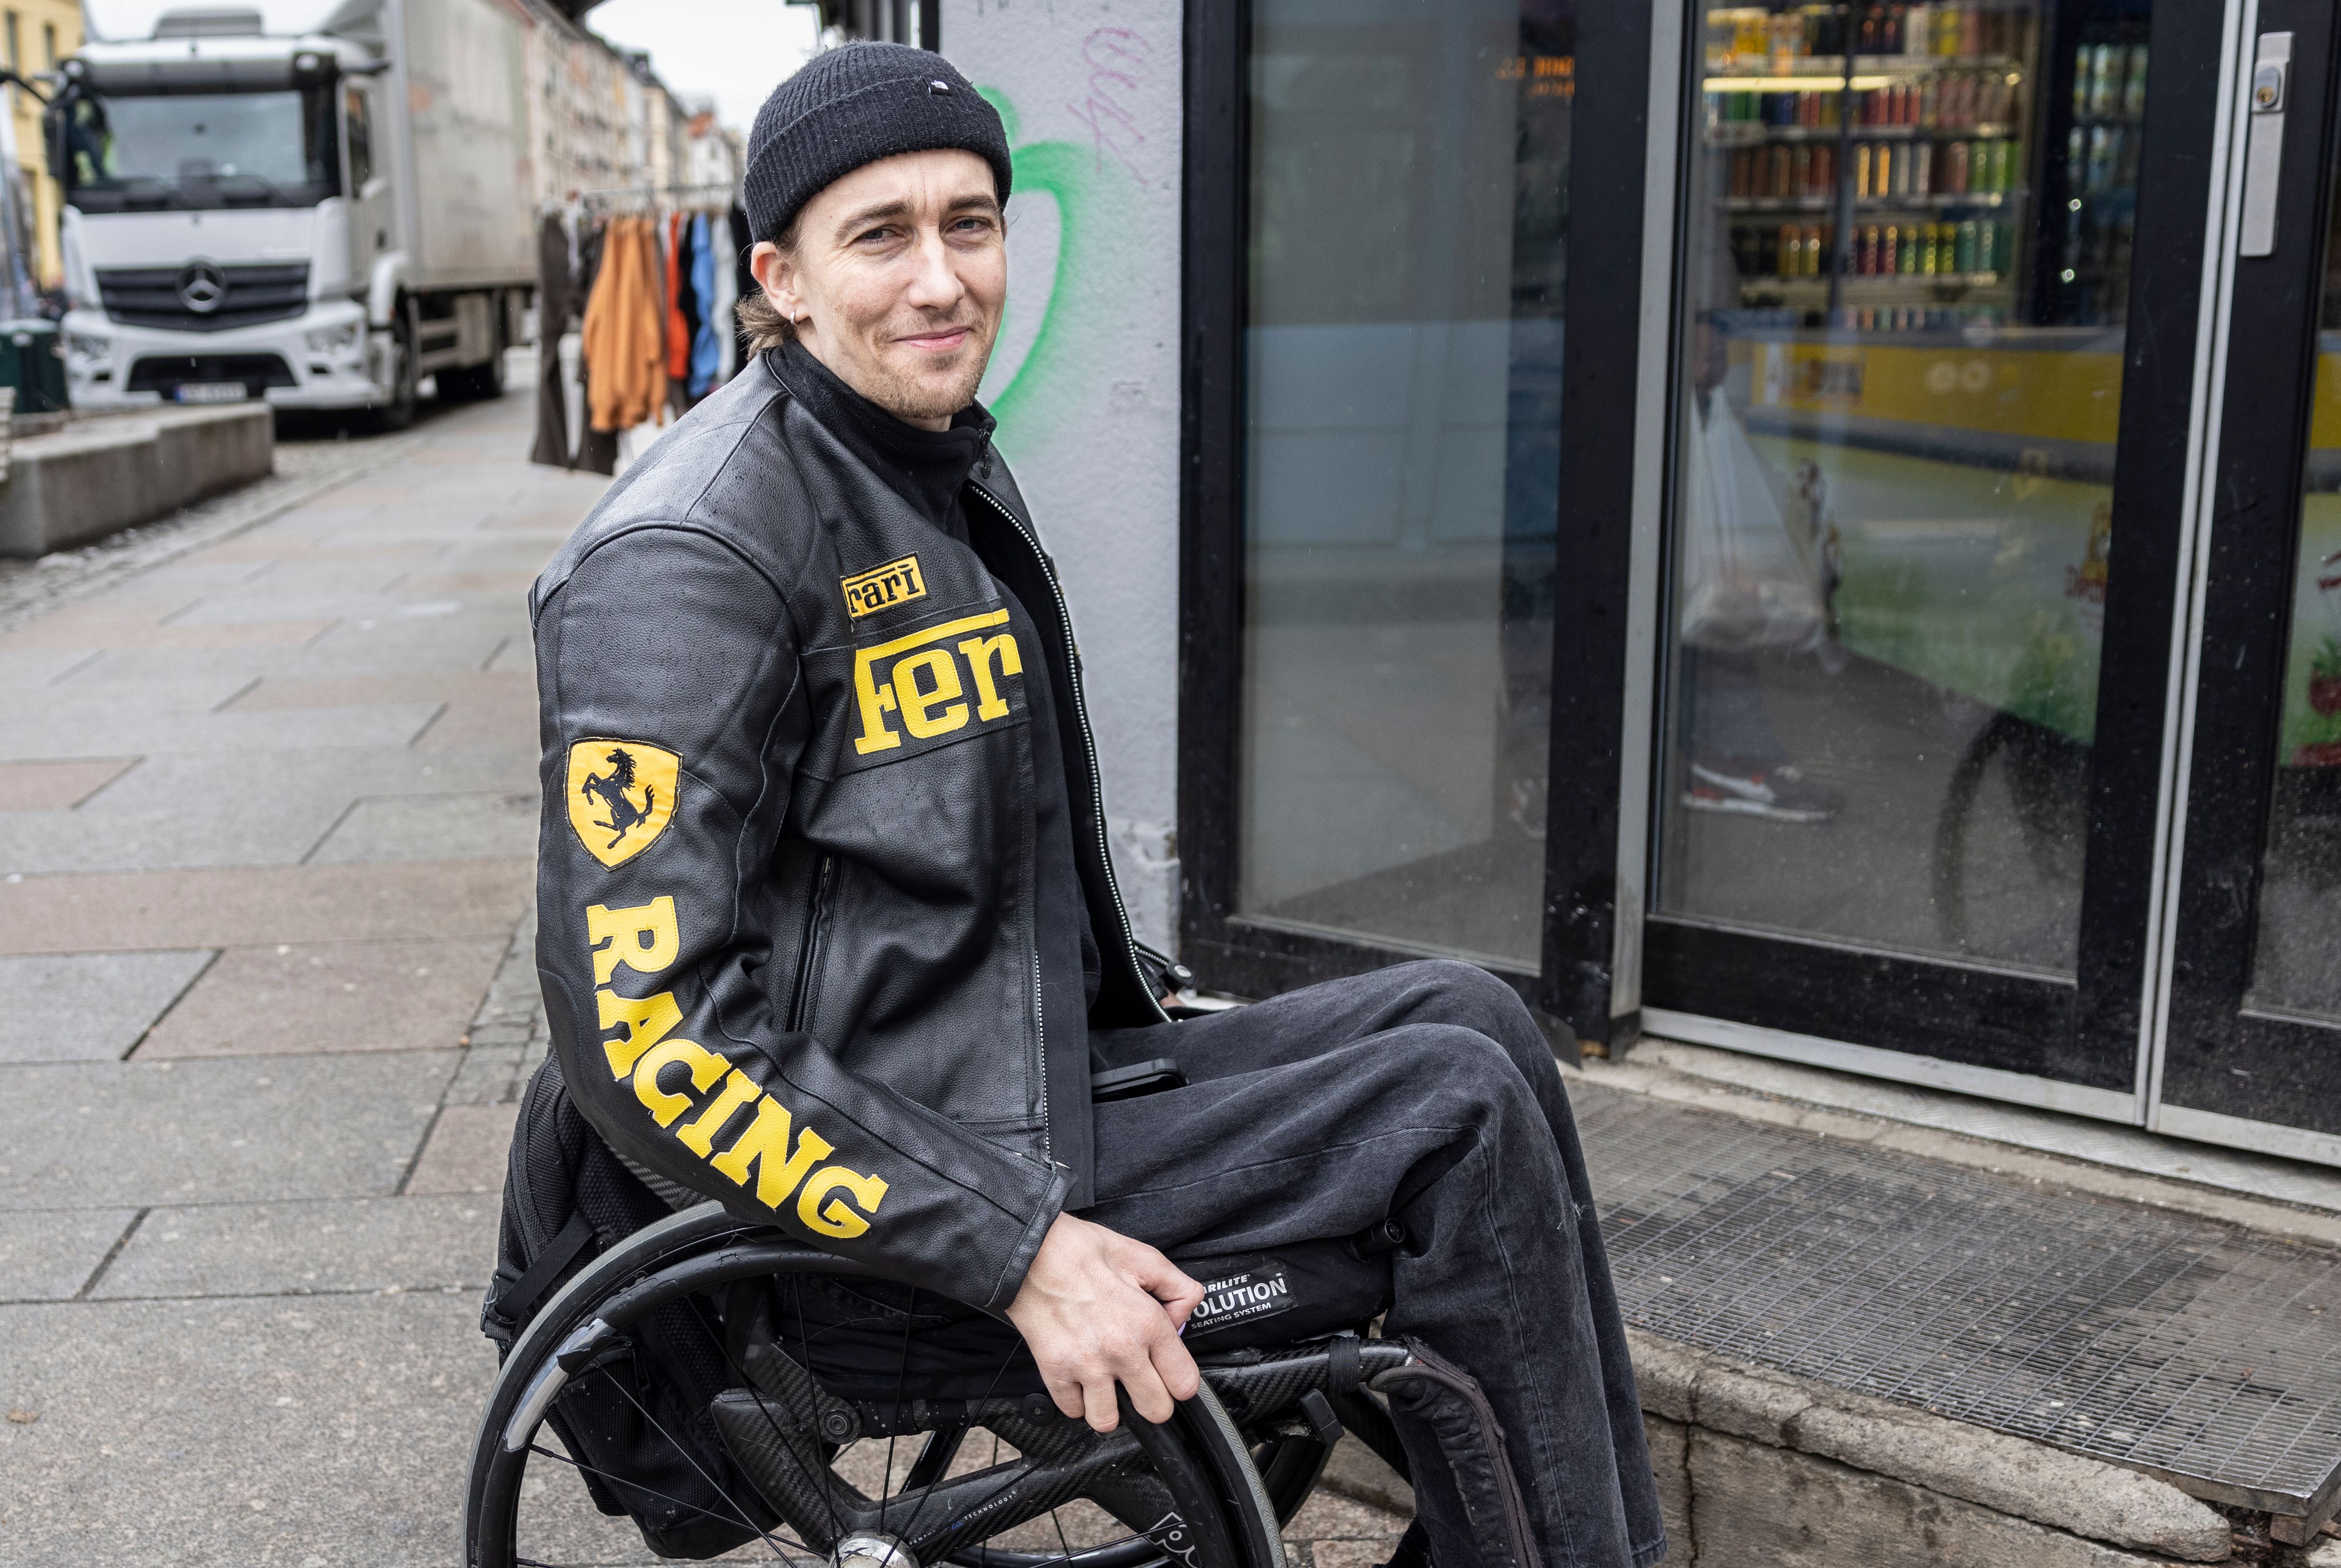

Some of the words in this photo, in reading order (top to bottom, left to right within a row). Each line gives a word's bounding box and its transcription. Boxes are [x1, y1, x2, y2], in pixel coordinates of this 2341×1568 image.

[845, 563, 920, 614] rari
[854, 608, 1023, 754] Fer
[586, 895, 889, 1239] RACING
[1188, 1277, 1287, 1320] OLUTION
[1204, 1274, 1248, 1294] RILITE
[1191, 1314, 1232, 1329] SEATING
[1233, 1302, 1272, 1318] SYSTEM
[964, 1495, 1013, 1520] TECHNOLOGY
